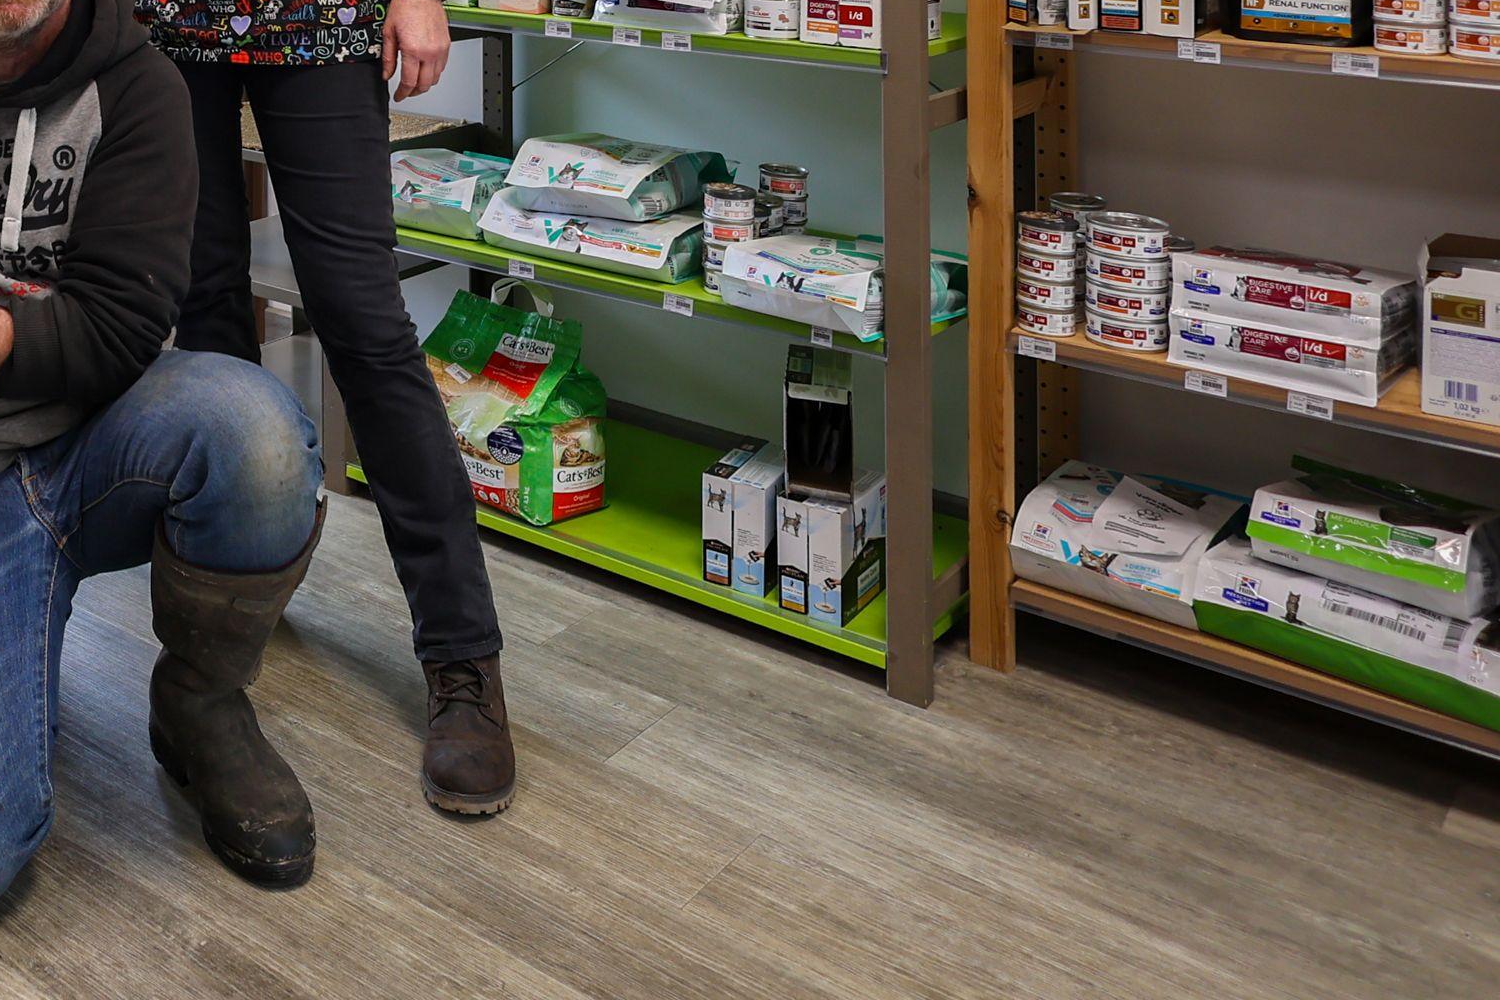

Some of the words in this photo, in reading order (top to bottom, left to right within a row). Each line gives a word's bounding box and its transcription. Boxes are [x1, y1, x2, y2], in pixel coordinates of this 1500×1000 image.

[810, 2, 836, 10] DIGESTIVE
[849, 11, 863, 20] i/d
[1269, 0, 1298, 8] RENAL
[1301, 2, 1347, 11] FUNCTION
[271, 33, 310, 45] LOVE
[313, 26, 335, 59] My
[332, 27, 369, 55] Dog
[254, 52, 284, 62] WHO
[1249, 280, 1293, 293] DIGESTIVE
[1310, 289, 1327, 302] i/d
[1249, 286, 1272, 296] CARE
[1456, 303, 1479, 320] G
[1244, 329, 1289, 344] DIGESTIVE
[1304, 342, 1323, 354] i/d
[1244, 337, 1267, 347] CARE
[1470, 405, 1480, 414] kg
[476, 464, 500, 480] Best
[557, 470, 583, 483] Cat's
[1331, 514, 1379, 529] METABOLIC
